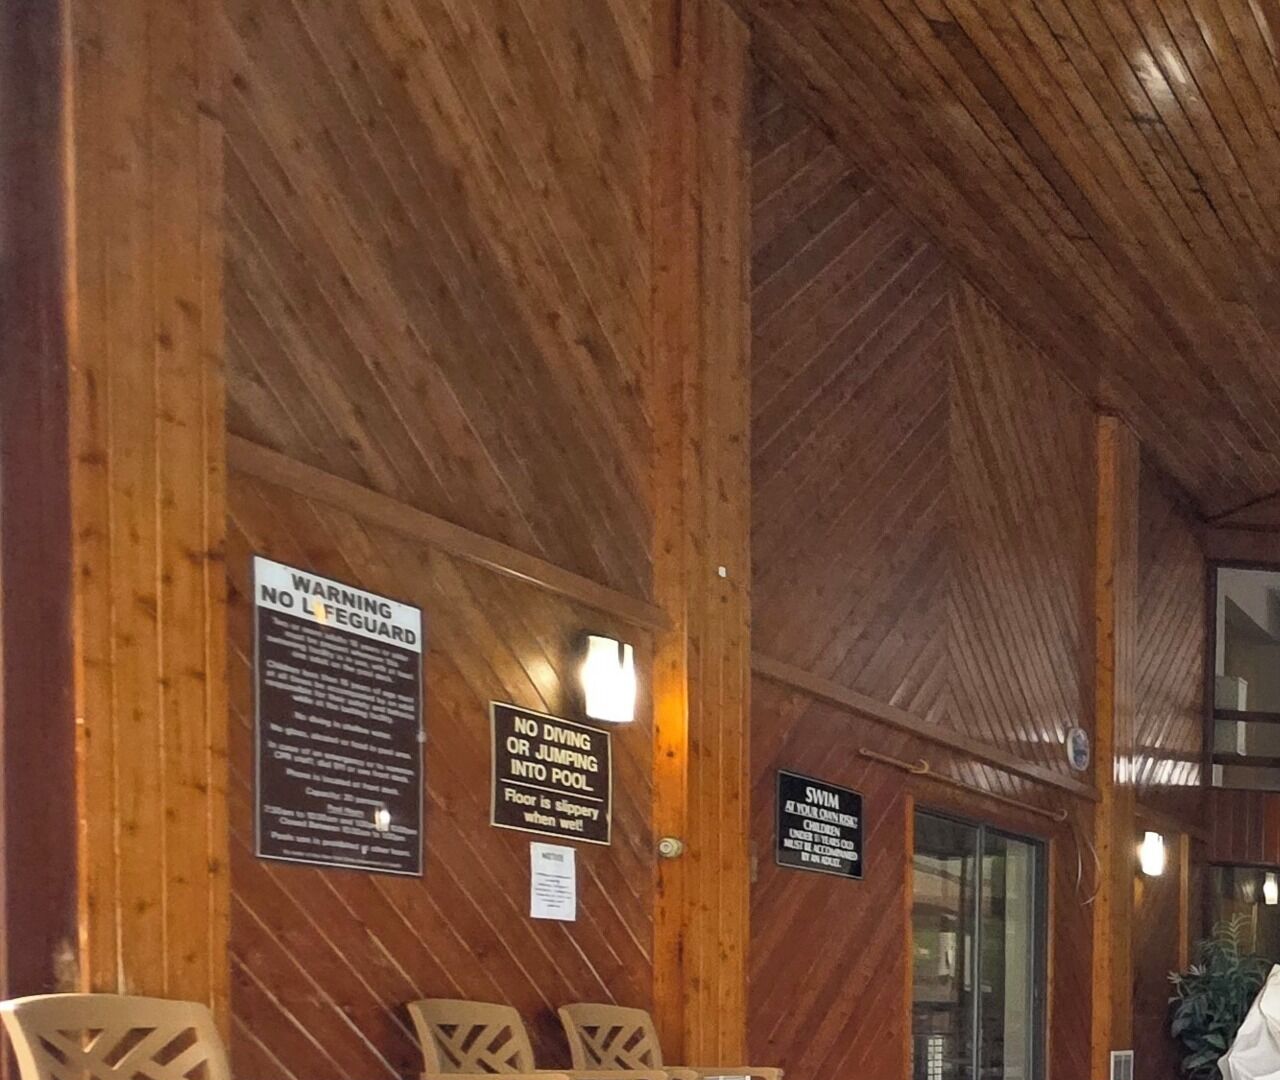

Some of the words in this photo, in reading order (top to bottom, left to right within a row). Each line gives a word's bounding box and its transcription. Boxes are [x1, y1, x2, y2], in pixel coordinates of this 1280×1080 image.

[291, 573, 392, 619] WARNING
[261, 585, 293, 608] NO
[303, 597, 416, 645] LFEGUARD
[514, 716, 538, 737] NO
[544, 723, 591, 750] DIVING
[506, 738, 530, 757] OR
[535, 744, 598, 772] JUMPING
[511, 759, 546, 781] INTO
[504, 788, 536, 806] Floor
[540, 795, 551, 809] is
[555, 799, 599, 820] slippery
[805, 787, 839, 809] SWIM
[524, 811, 556, 827] when
[560, 817, 584, 832] wet!
[796, 802, 818, 819] YOUR
[819, 808, 839, 822] OWN
[789, 828, 813, 842] UNDER
[803, 819, 841, 837] CHILDREN
[783, 838, 803, 851] MUST
